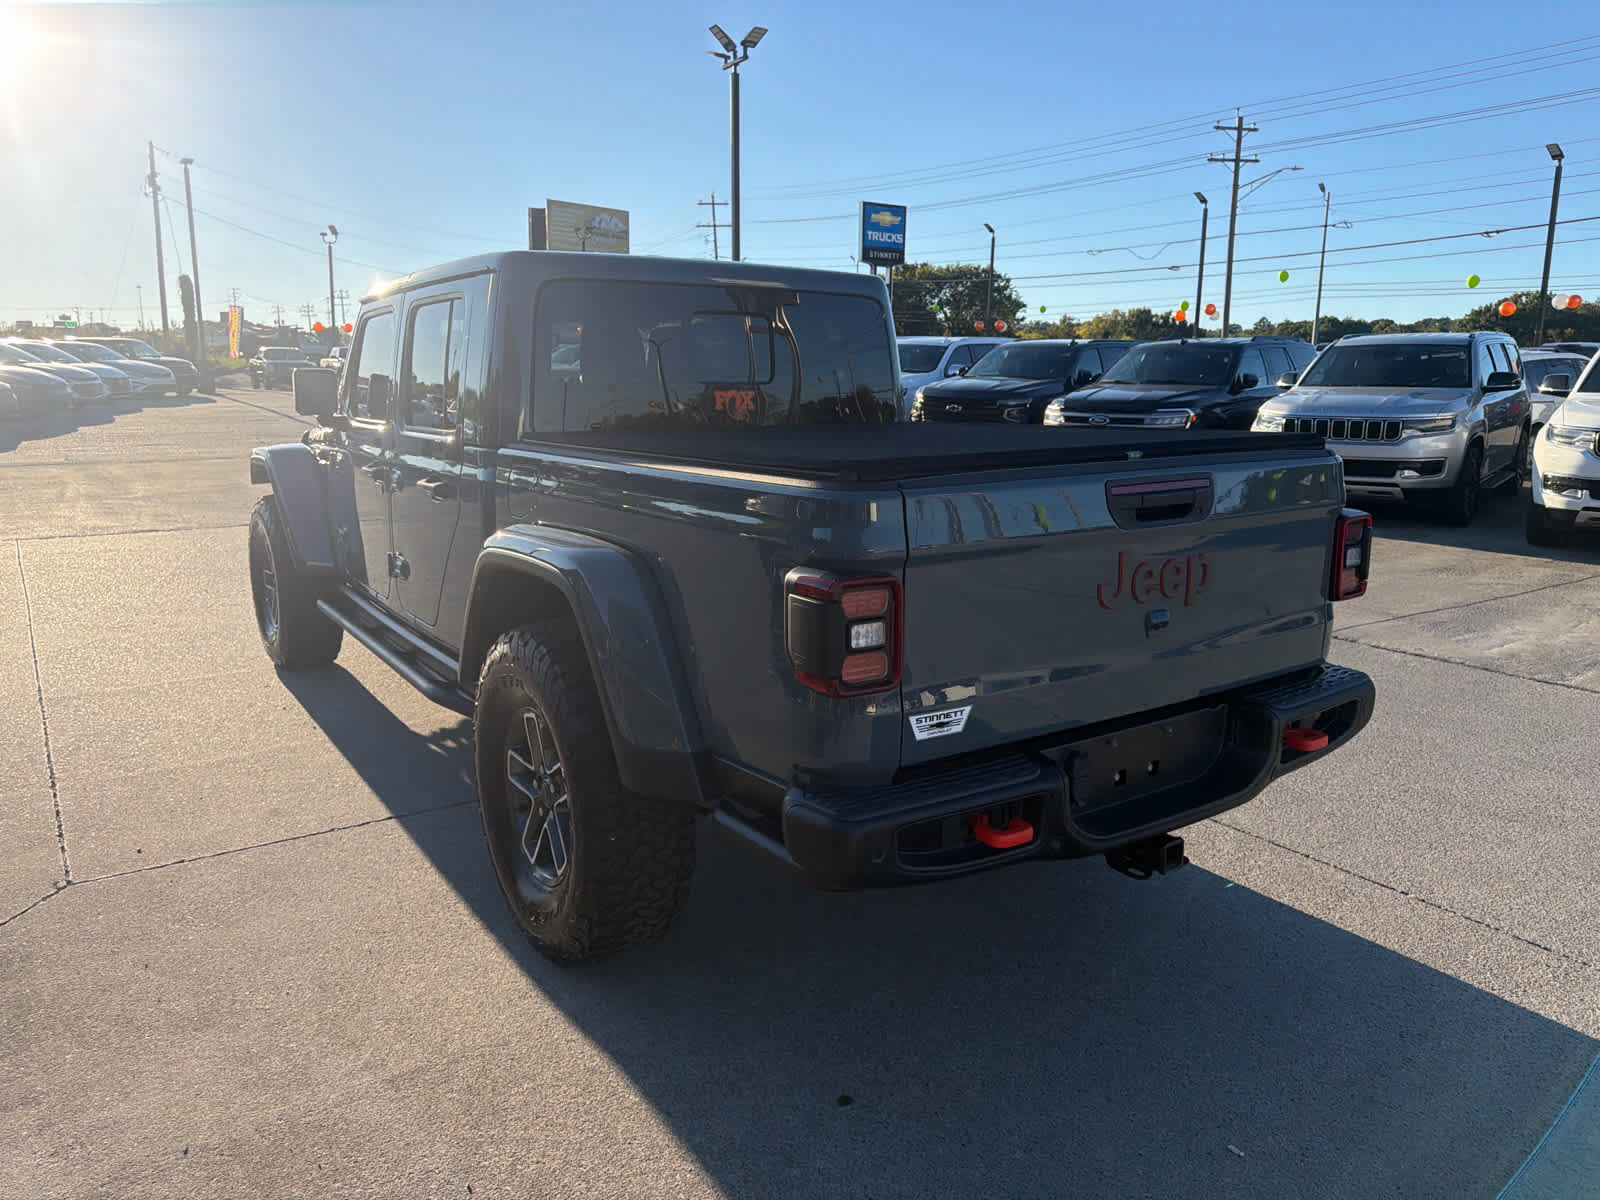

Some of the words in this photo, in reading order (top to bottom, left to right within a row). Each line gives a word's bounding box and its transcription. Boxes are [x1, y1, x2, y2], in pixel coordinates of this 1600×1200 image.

[866, 231, 903, 243] TRUCKS
[715, 389, 755, 411] FOX
[1097, 549, 1208, 610] Jeep
[915, 708, 967, 725] STINNETT
